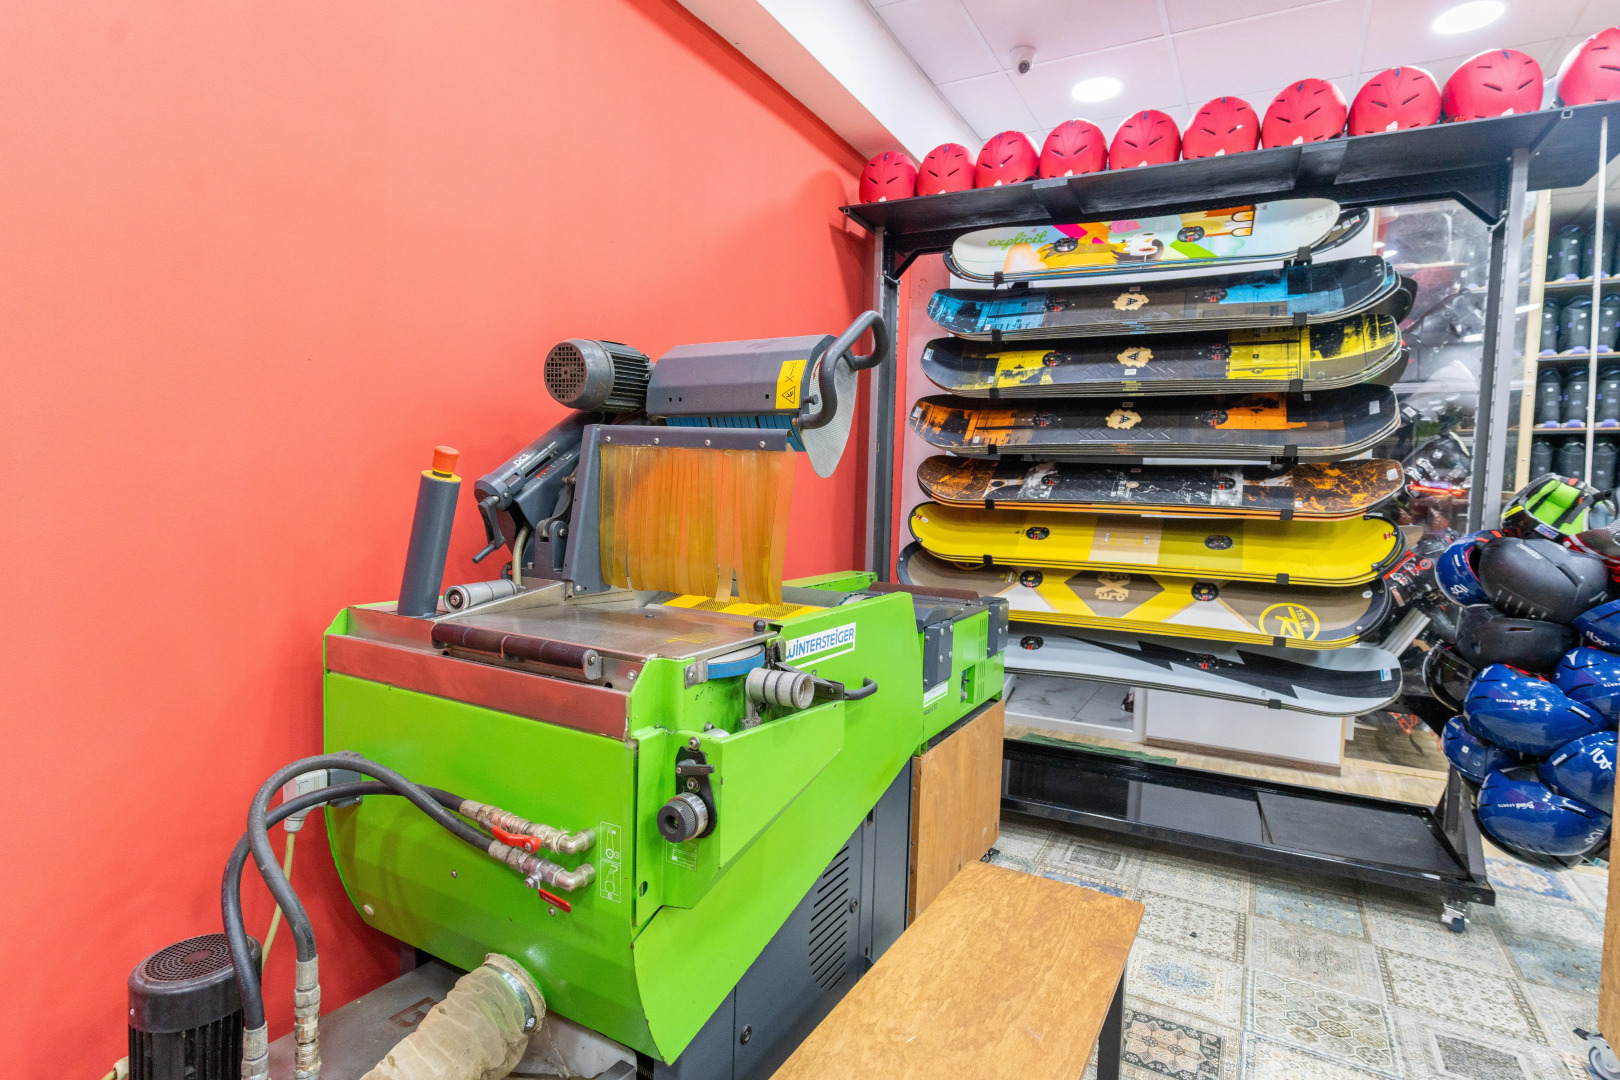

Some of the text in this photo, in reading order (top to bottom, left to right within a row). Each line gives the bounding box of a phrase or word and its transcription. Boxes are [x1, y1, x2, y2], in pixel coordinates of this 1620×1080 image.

[988, 230, 1048, 251] explicit
[1296, 609, 1310, 628] 155 W
[785, 627, 855, 660] WINTERSTEIGER
